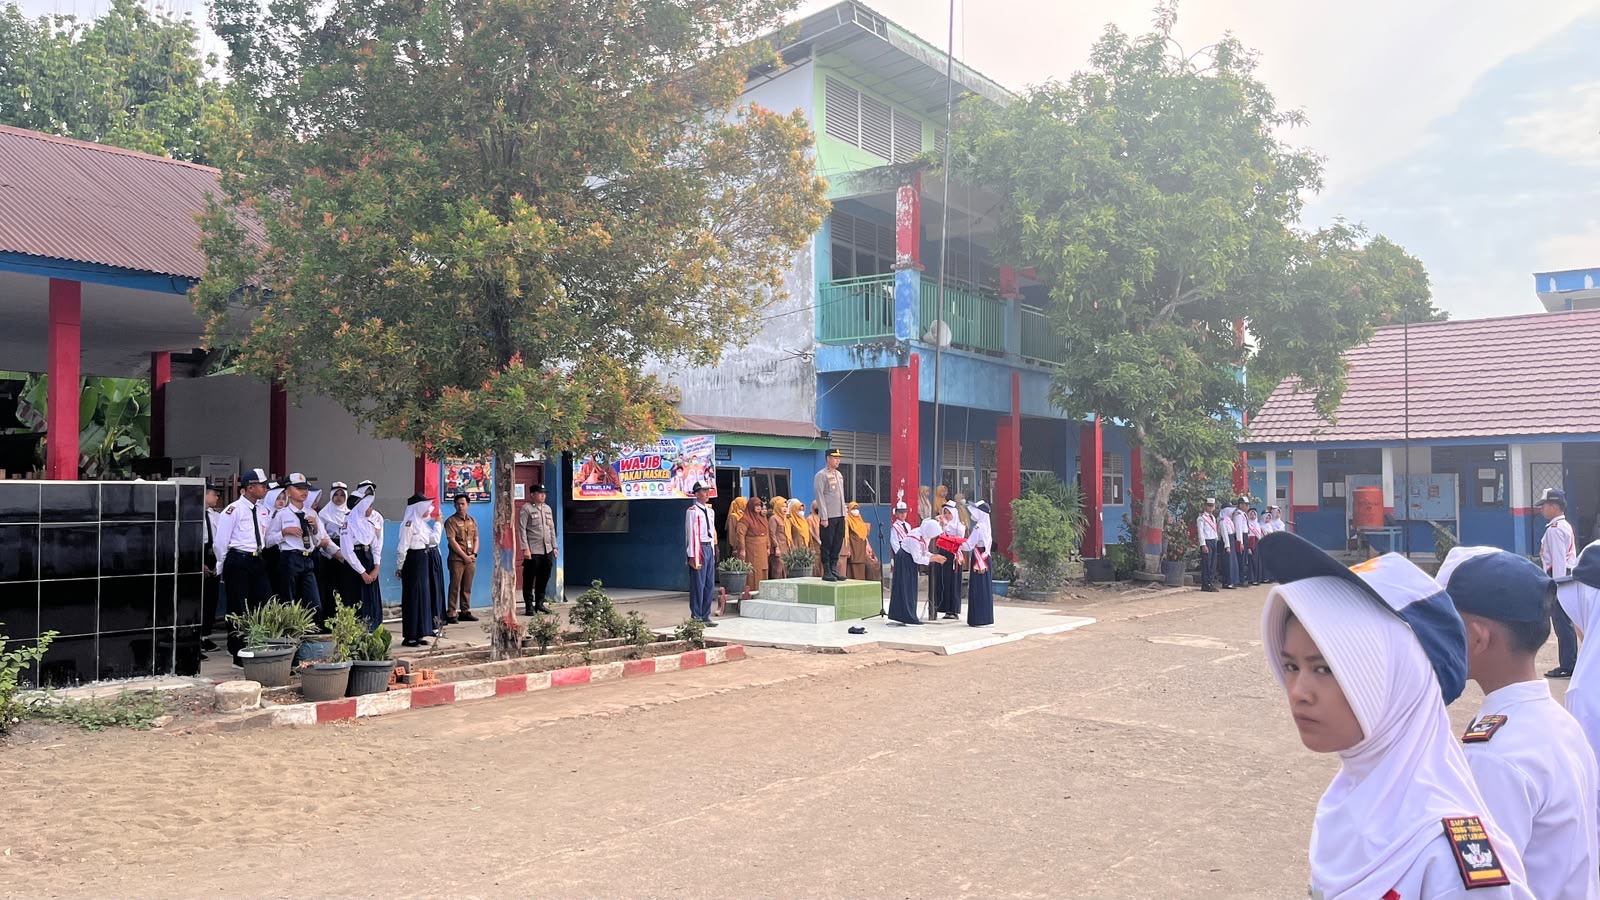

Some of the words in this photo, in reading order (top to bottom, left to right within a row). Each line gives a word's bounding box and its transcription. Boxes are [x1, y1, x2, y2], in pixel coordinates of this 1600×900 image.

[620, 455, 661, 471] WAJIB
[620, 471, 642, 482] PAKAI
[643, 470, 671, 480] MASKER
[1450, 819, 1465, 827] SMP
